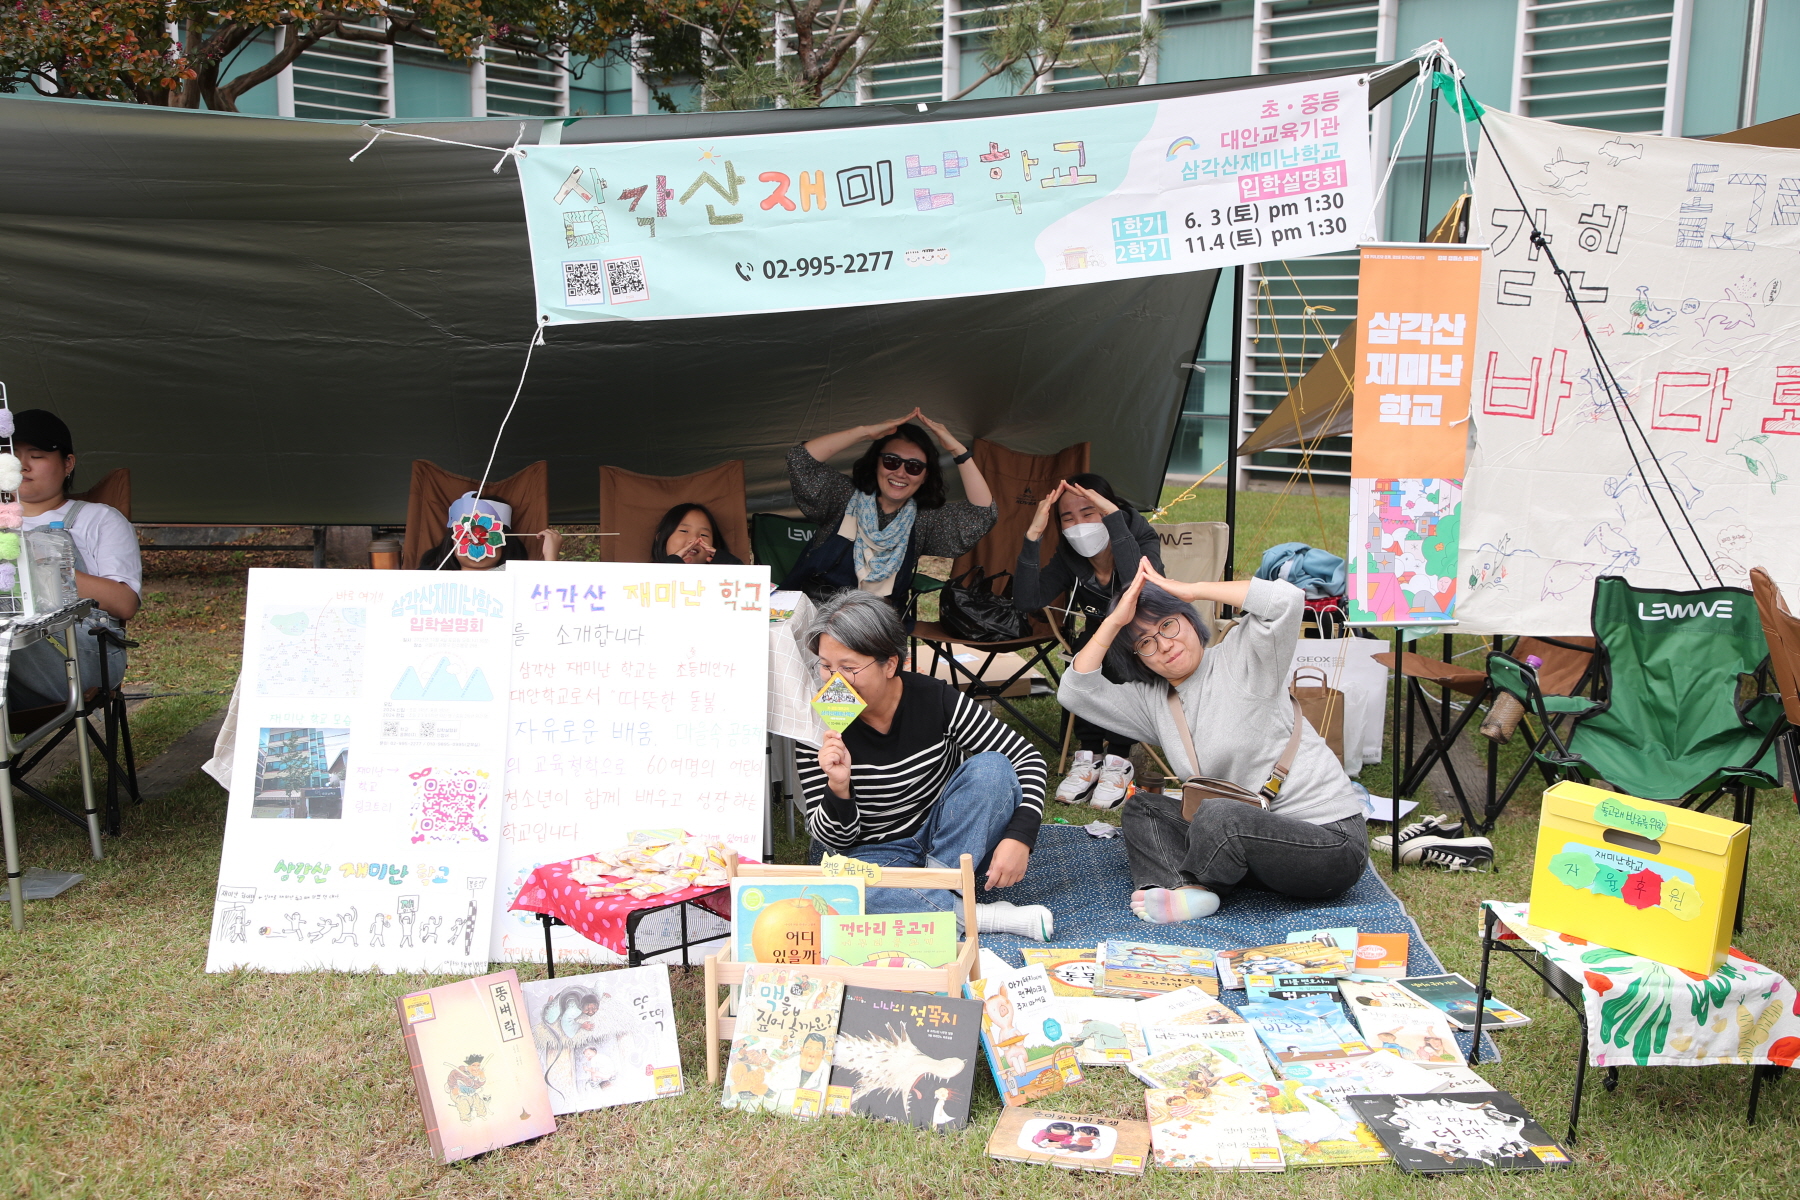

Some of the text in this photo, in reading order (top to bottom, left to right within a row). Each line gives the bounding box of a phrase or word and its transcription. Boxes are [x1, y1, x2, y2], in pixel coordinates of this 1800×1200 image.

[1220, 115, 1340, 151] 대안교육기관
[1180, 141, 1342, 182] 삼각산재미난학교
[1240, 164, 1343, 199] 입학설명회
[1112, 215, 1163, 238] 1학기
[1225, 202, 1260, 227] (토)
[1268, 202, 1299, 221] pm
[1303, 192, 1345, 214] 1:30
[1115, 217, 1347, 263] 2학기 11.4 (토) pm 1:30
[762, 250, 894, 281] 02-995-2277
[1367, 311, 1467, 346] 삼각산
[1365, 352, 1465, 387] 재미난
[1379, 394, 1443, 427] 학교
[391, 582, 504, 619] 삼각산재미난학교
[530, 579, 763, 613] 삼각산 재미난 학교
[410, 617, 484, 633] 입학설명회
[512, 622, 530, 647] 를
[519, 661, 556, 679] 삼각산
[566, 661, 611, 679] 재미난
[621, 661, 657, 679] 학교는
[510, 686, 601, 706] 대안학교로서
[269, 713, 305, 726] 재미난
[310, 712, 328, 725] 학교
[514, 717, 599, 745] 자유로운
[506, 757, 521, 774] 의
[534, 753, 627, 777] 교육철학으로
[504, 787, 569, 811] 청소년이
[584, 787, 620, 809] 함께
[635, 787, 684, 808] 배우고
[502, 821, 579, 845] 학교입니다
[274, 858, 332, 884] 삼각산
[338, 861, 409, 885] 재미난
[1594, 849, 1644, 872] 재미난학교
[785, 930, 814, 946] 어디
[839, 919, 935, 937] 꺽다리 물고기
[493, 984, 518, 1037] 똥벼락
[760, 984, 792, 1017] 맥을
[756, 1008, 785, 1033] 짚어
[872, 1000, 959, 1028] 니나의 젖꼭지
[1324, 1084, 1358, 1095] 아빠랑
[1033, 1110, 1067, 1120] 순이와
[1069, 1115, 1093, 1124] 어린
[1427, 1114, 1442, 1126] 덩
[1432, 1127, 1461, 1145] 덩
